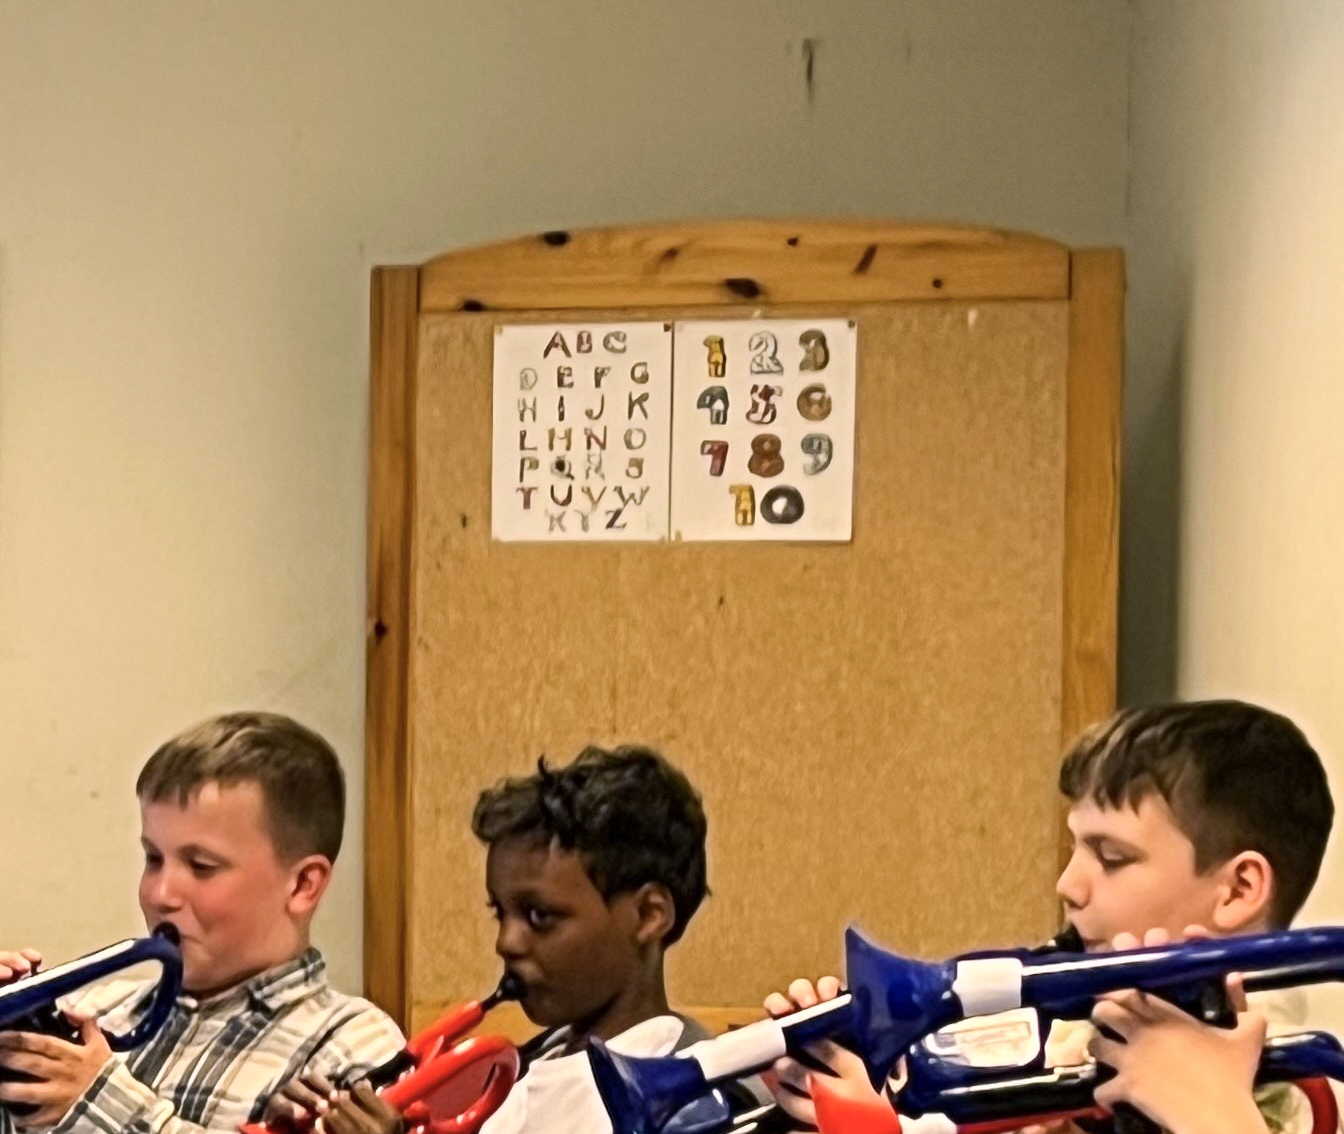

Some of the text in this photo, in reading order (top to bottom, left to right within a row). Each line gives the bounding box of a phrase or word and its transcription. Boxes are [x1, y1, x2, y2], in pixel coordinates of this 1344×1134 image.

[544, 331, 627, 358] A B C
[703, 329, 829, 377] 1 2 3
[520, 366, 537, 391] D
[557, 366, 573, 388] E
[517, 392, 649, 421] H I J K
[520, 430, 537, 450] L
[585, 426, 606, 450] N
[624, 428, 645, 450] O
[519, 456, 539, 482] P
[550, 454, 574, 479] Q
[700, 433, 833, 477] 7 8 9
[516, 486, 539, 509] T
[551, 485, 571, 506] U
[614, 485, 649, 507] W
[729, 484, 804, 526] 10
[604, 508, 627, 529] Z
